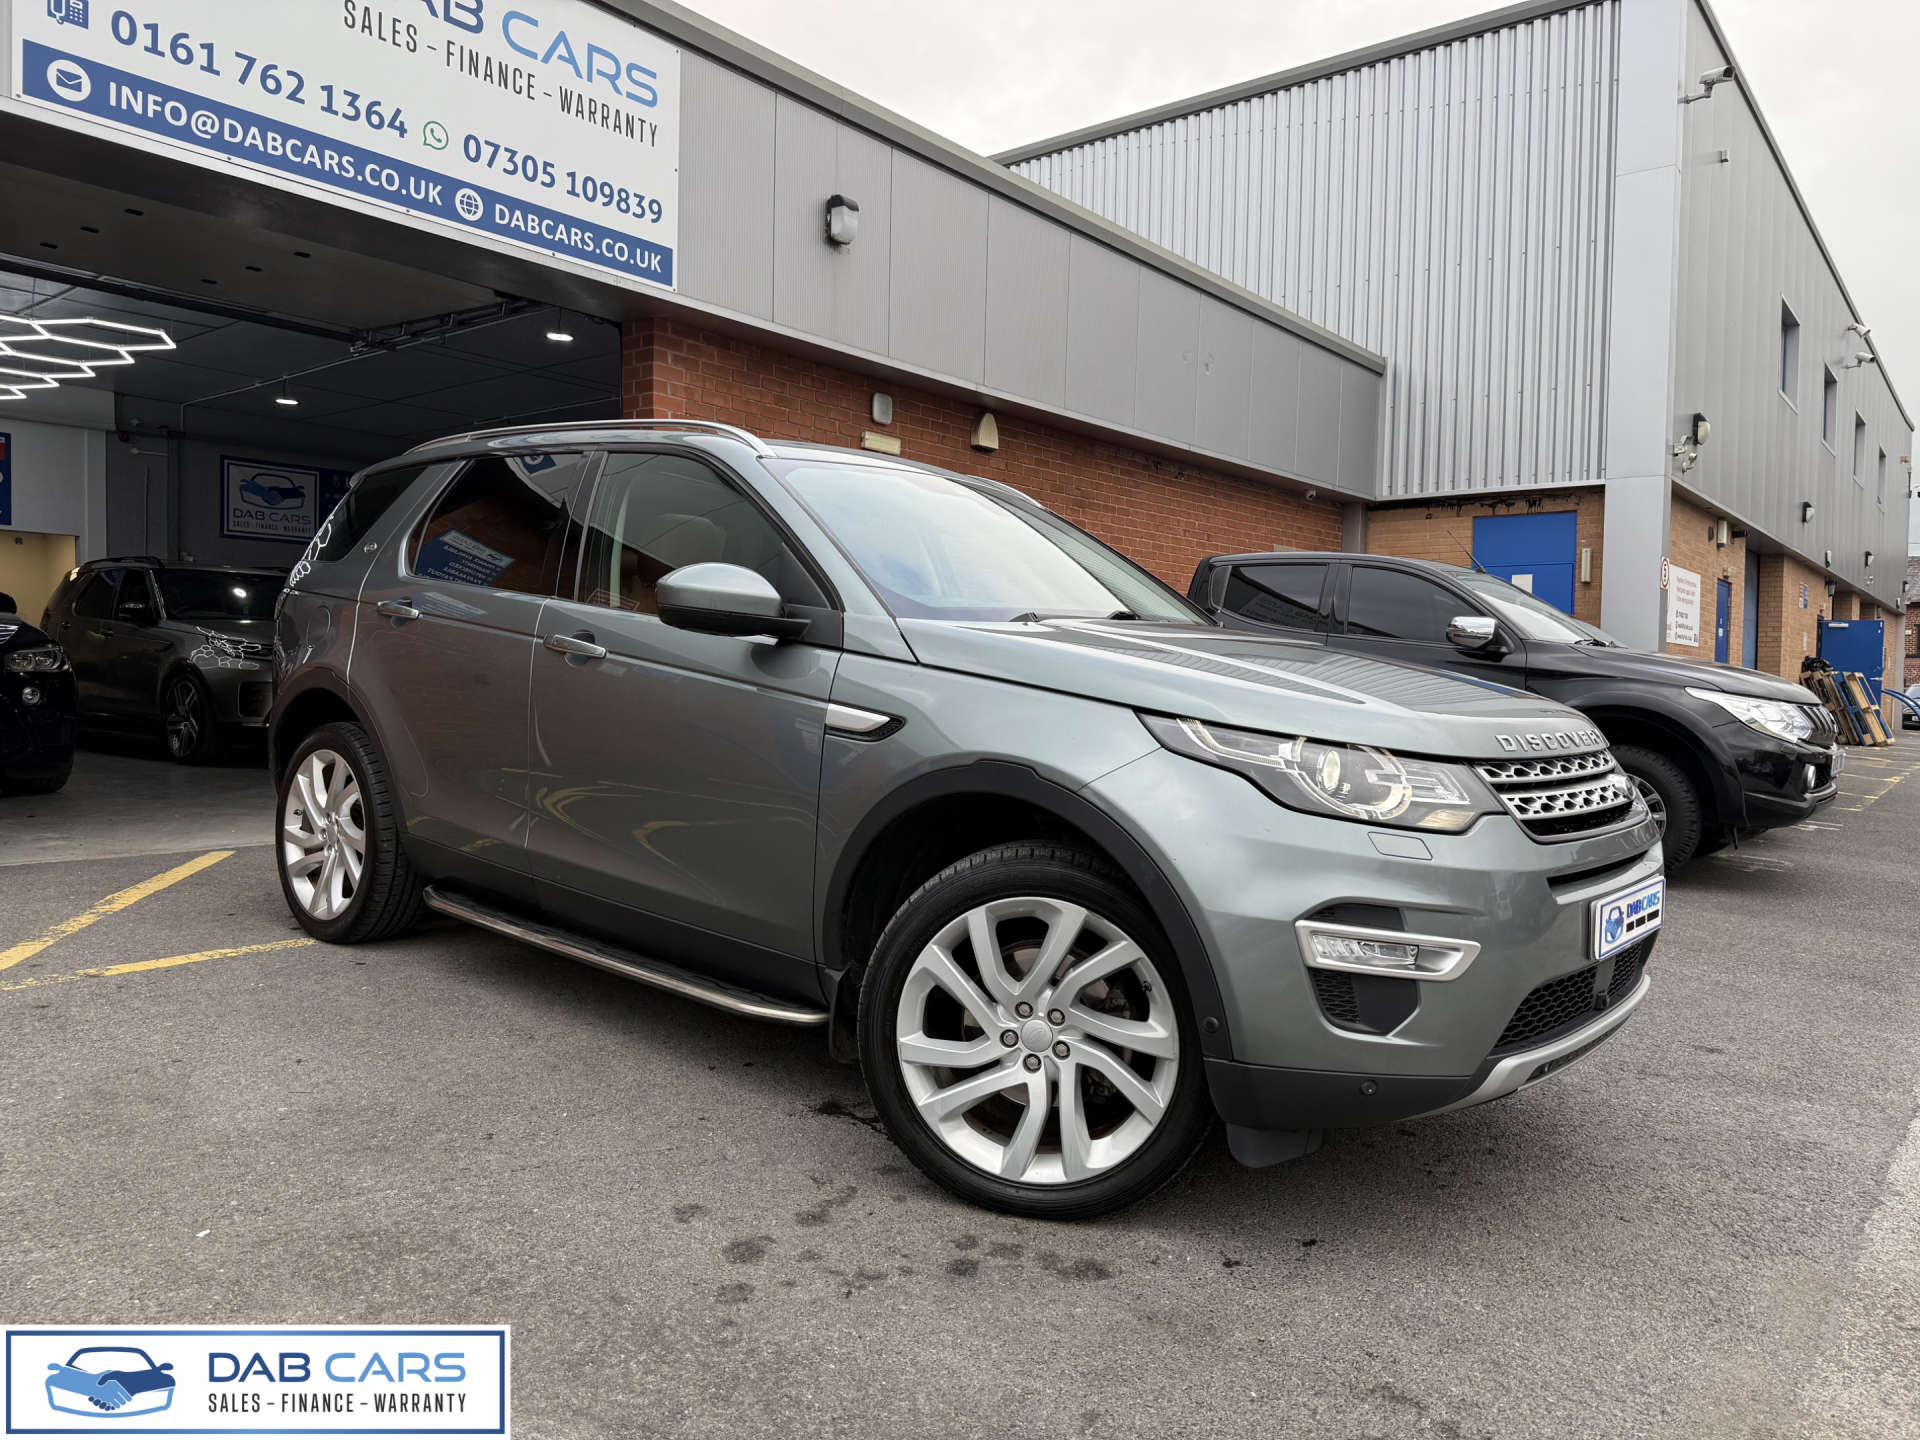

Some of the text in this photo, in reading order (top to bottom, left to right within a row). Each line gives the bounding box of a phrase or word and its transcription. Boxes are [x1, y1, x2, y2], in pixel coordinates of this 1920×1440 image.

[111, 10, 663, 224] 0161 762 1364 07305 109839
[344, 0, 417, 53] SALES
[446, 40, 536, 101] FINANCE
[559, 86, 659, 148] WARRANTY
[502, 10, 659, 108] CARS
[108, 81, 662, 273] INFO@DABCARS.CO.UK DABCARS.CO.UK
[232, 509, 312, 525] DAB CARS
